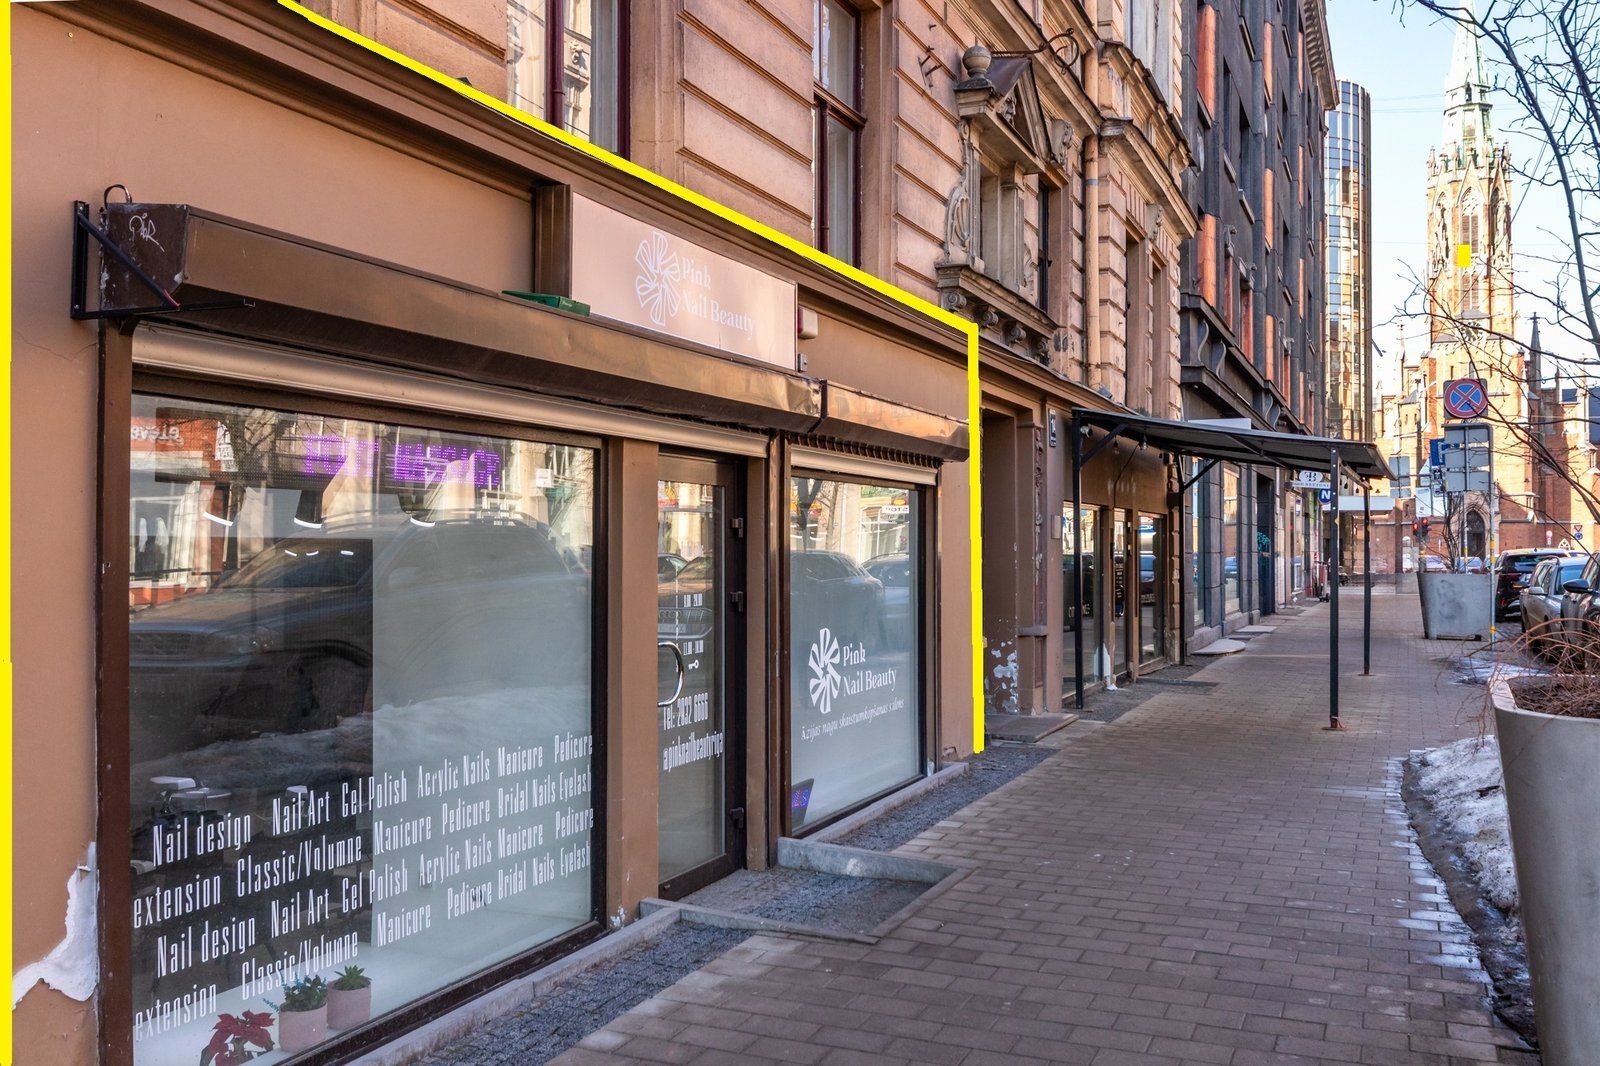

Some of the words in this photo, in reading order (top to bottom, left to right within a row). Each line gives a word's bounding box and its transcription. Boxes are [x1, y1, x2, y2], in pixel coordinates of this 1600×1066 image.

[682, 257, 711, 289] Pink
[682, 288, 707, 319] Nail
[710, 299, 754, 340] Beauty
[843, 641, 866, 666] Pink
[843, 670, 863, 697] Nail
[865, 667, 897, 692] Beauty
[153, 817, 188, 867] Nail
[196, 812, 251, 856] design
[272, 791, 302, 836] Nail
[308, 790, 330, 827] Art
[342, 778, 362, 818] Gel
[368, 770, 407, 811] Polish
[417, 758, 459, 798] Acrylic
[463, 750, 490, 786] Nails
[497, 746, 543, 777] Manicure
[554, 732, 593, 764] Pedicure
[133, 874, 221, 929] extension
[374, 817, 431, 856] Manicure
[442, 798, 490, 835] Pedicure
[498, 780, 528, 818] Bridal
[532, 774, 556, 808] Nails
[559, 764, 592, 802] Eyelash
[157, 926, 192, 979] Nail
[201, 917, 256, 963] design
[271, 892, 300, 939] Nail
[307, 889, 330, 926] Art
[342, 872, 363, 913] Gel
[369, 858, 408, 904] Polish
[419, 844, 460, 887] Acrylic
[465, 833, 492, 870] Nails
[497, 824, 543, 859] Manicure
[555, 806, 594, 839] Pedicure
[135, 983, 217, 1042] extension
[377, 904, 431, 948] Manicure
[447, 881, 492, 920] Pedicure
[498, 860, 527, 900] Bridal
[532, 852, 555, 886] Nails
[560, 840, 591, 878] Eyelash
